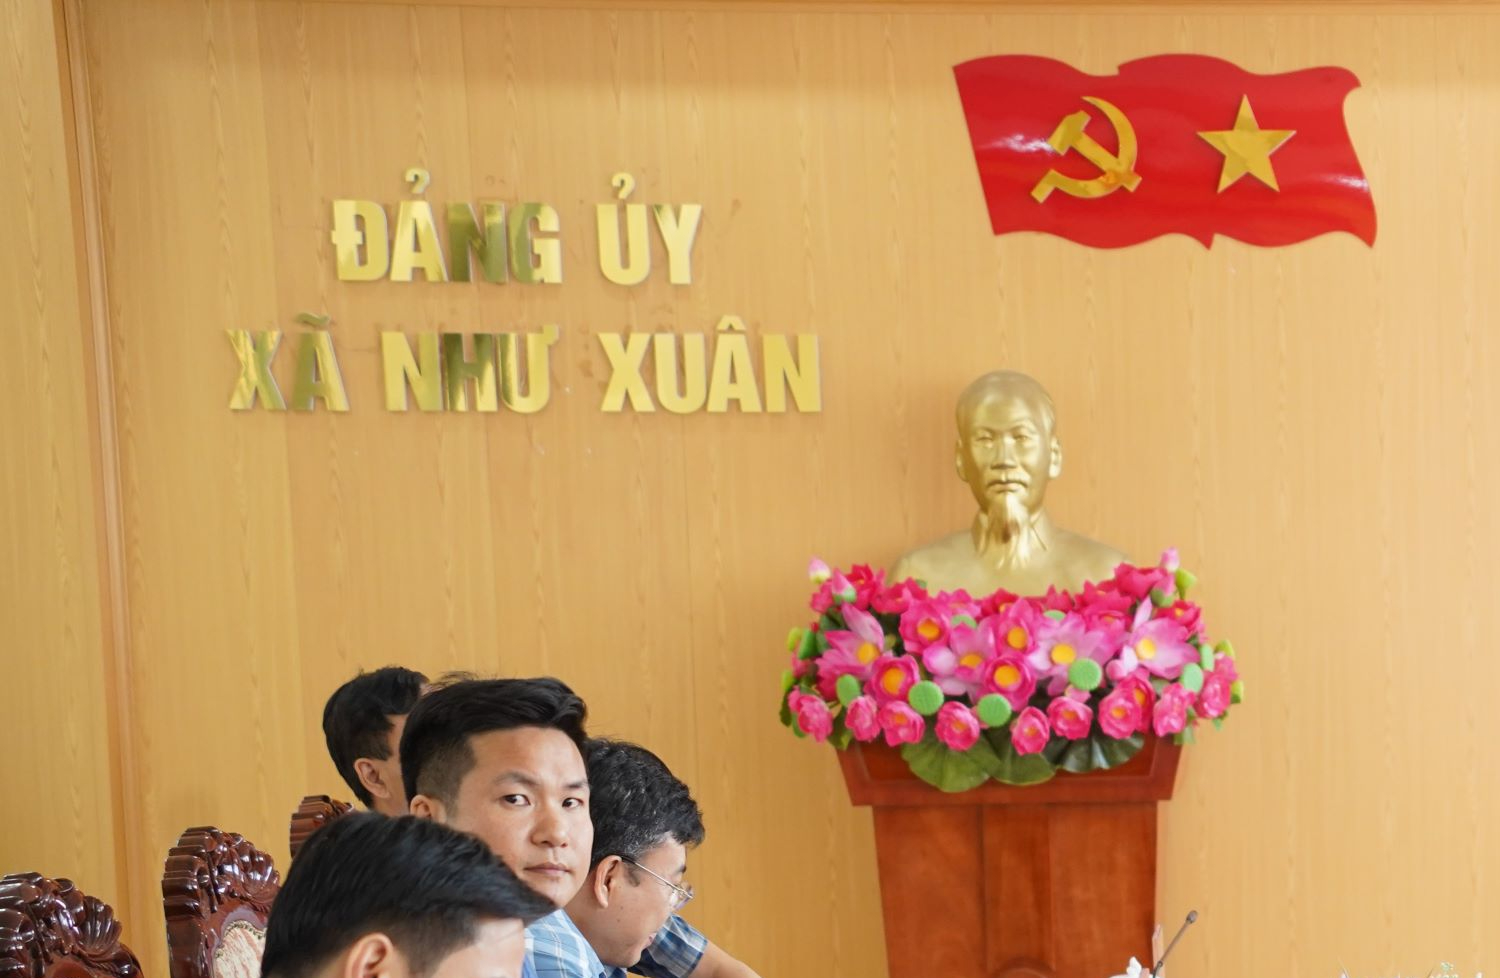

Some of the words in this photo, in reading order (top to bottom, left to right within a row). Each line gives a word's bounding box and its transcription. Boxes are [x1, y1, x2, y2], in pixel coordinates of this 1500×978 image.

[331, 167, 563, 285] ĐẢNG
[596, 172, 703, 286] ỦY
[226, 312, 350, 411] XÃ
[380, 324, 560, 413] NHƯ
[596, 315, 822, 414] XUÂN
